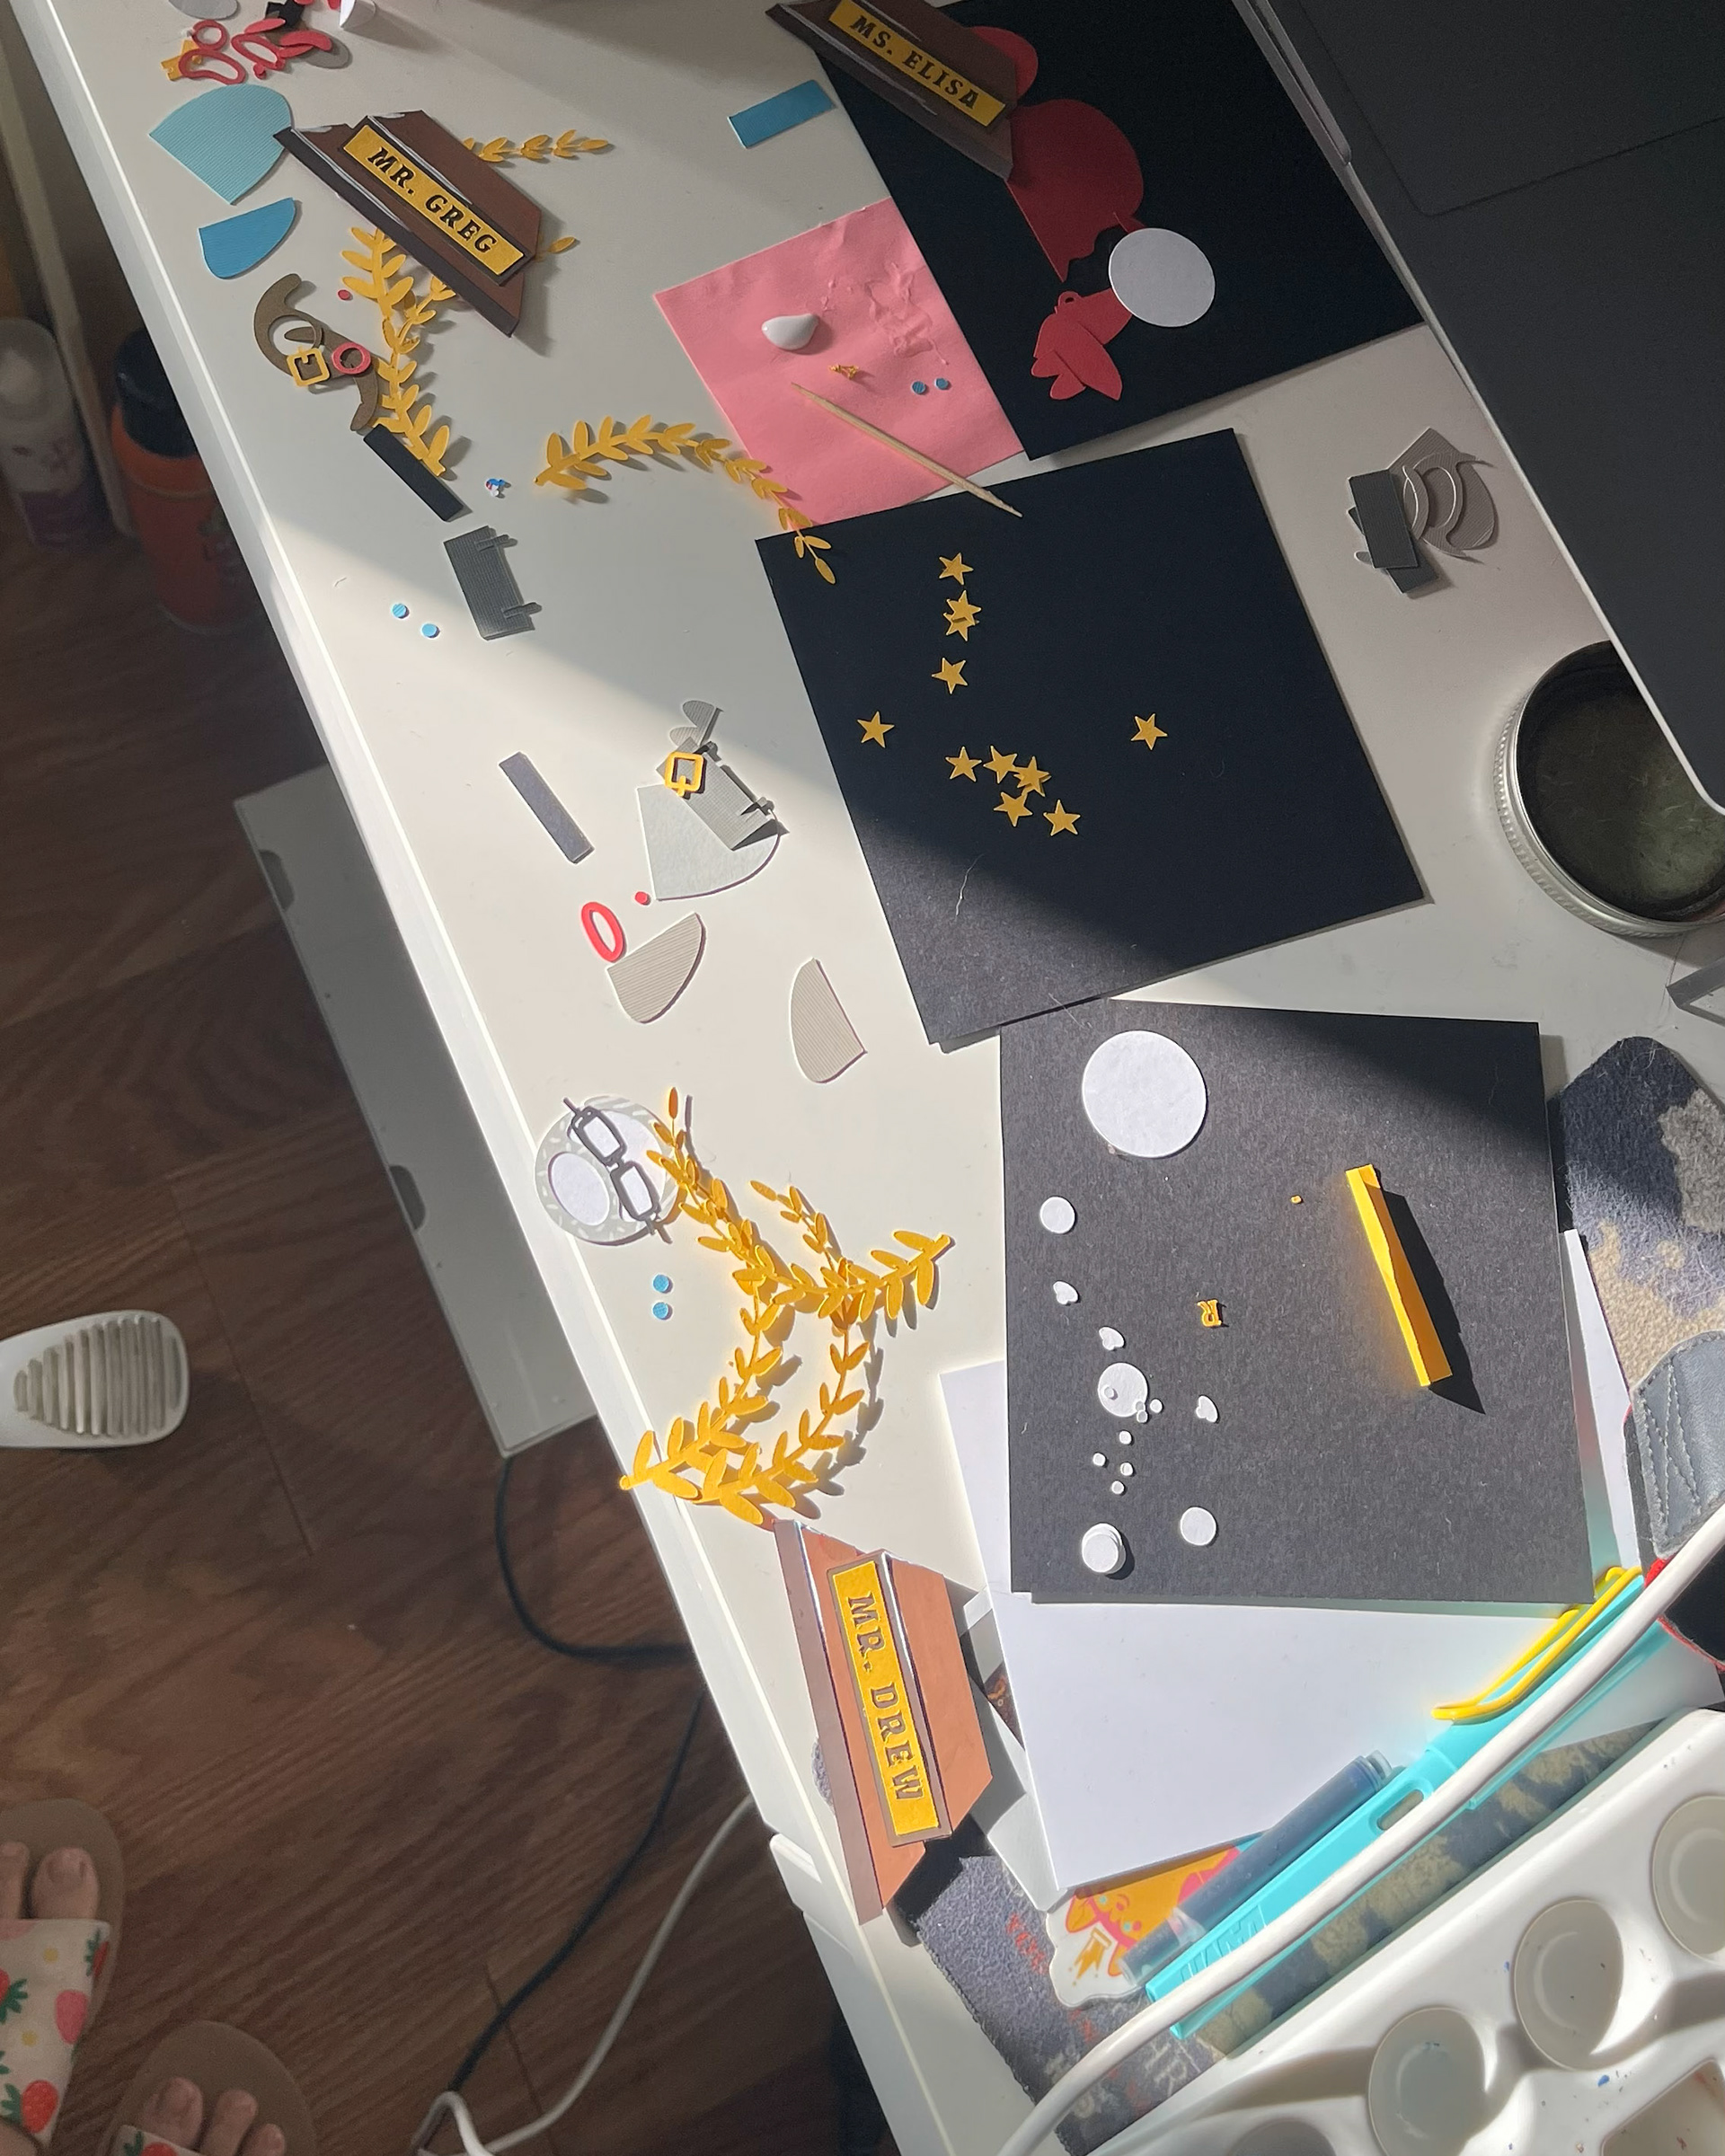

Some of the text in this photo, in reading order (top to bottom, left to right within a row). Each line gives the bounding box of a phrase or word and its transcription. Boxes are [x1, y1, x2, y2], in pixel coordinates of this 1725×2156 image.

[850, 14, 979, 110] MS. ELISA
[367, 146, 497, 253] MR. GREG
[848, 1591, 924, 1800] MR. DREW
